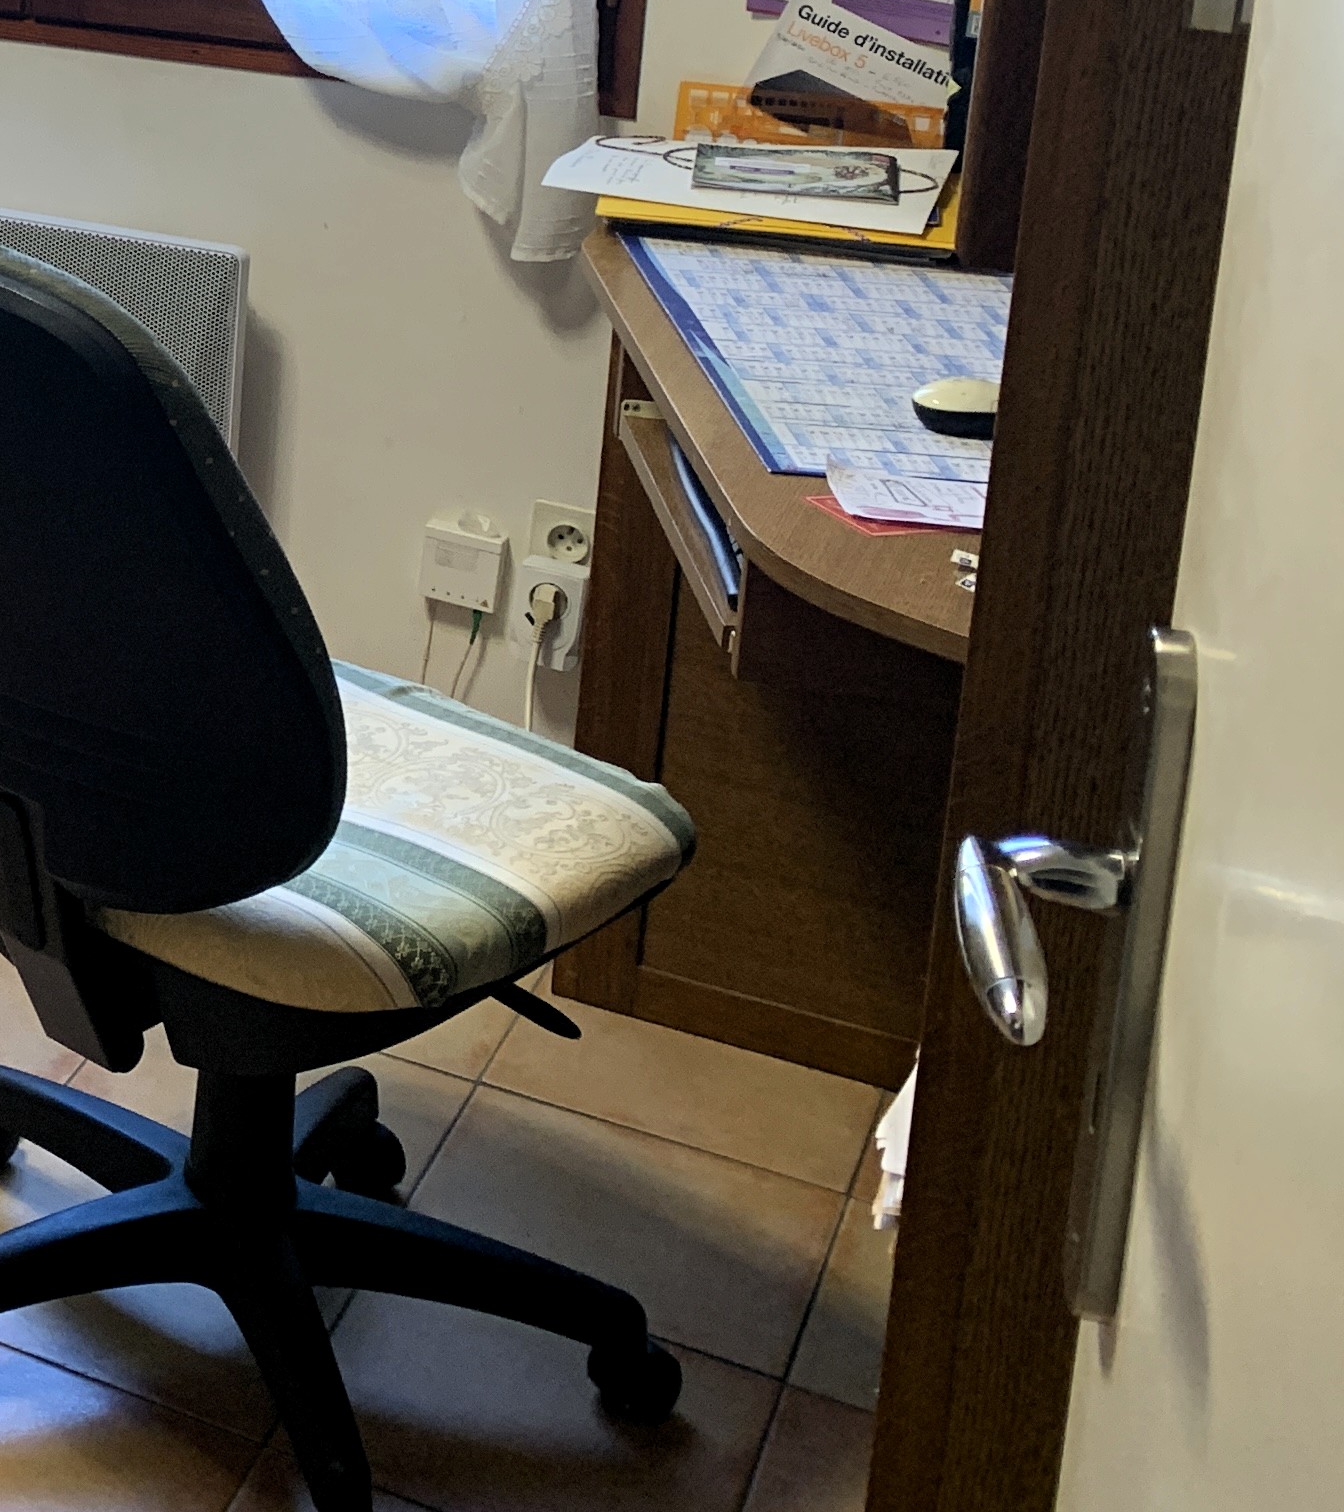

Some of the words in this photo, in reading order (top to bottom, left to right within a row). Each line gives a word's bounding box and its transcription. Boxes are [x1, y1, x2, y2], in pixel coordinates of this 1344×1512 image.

[798, 4, 850, 39] Guide
[786, 20, 852, 62] Livebox
[854, 54, 869, 69] 5
